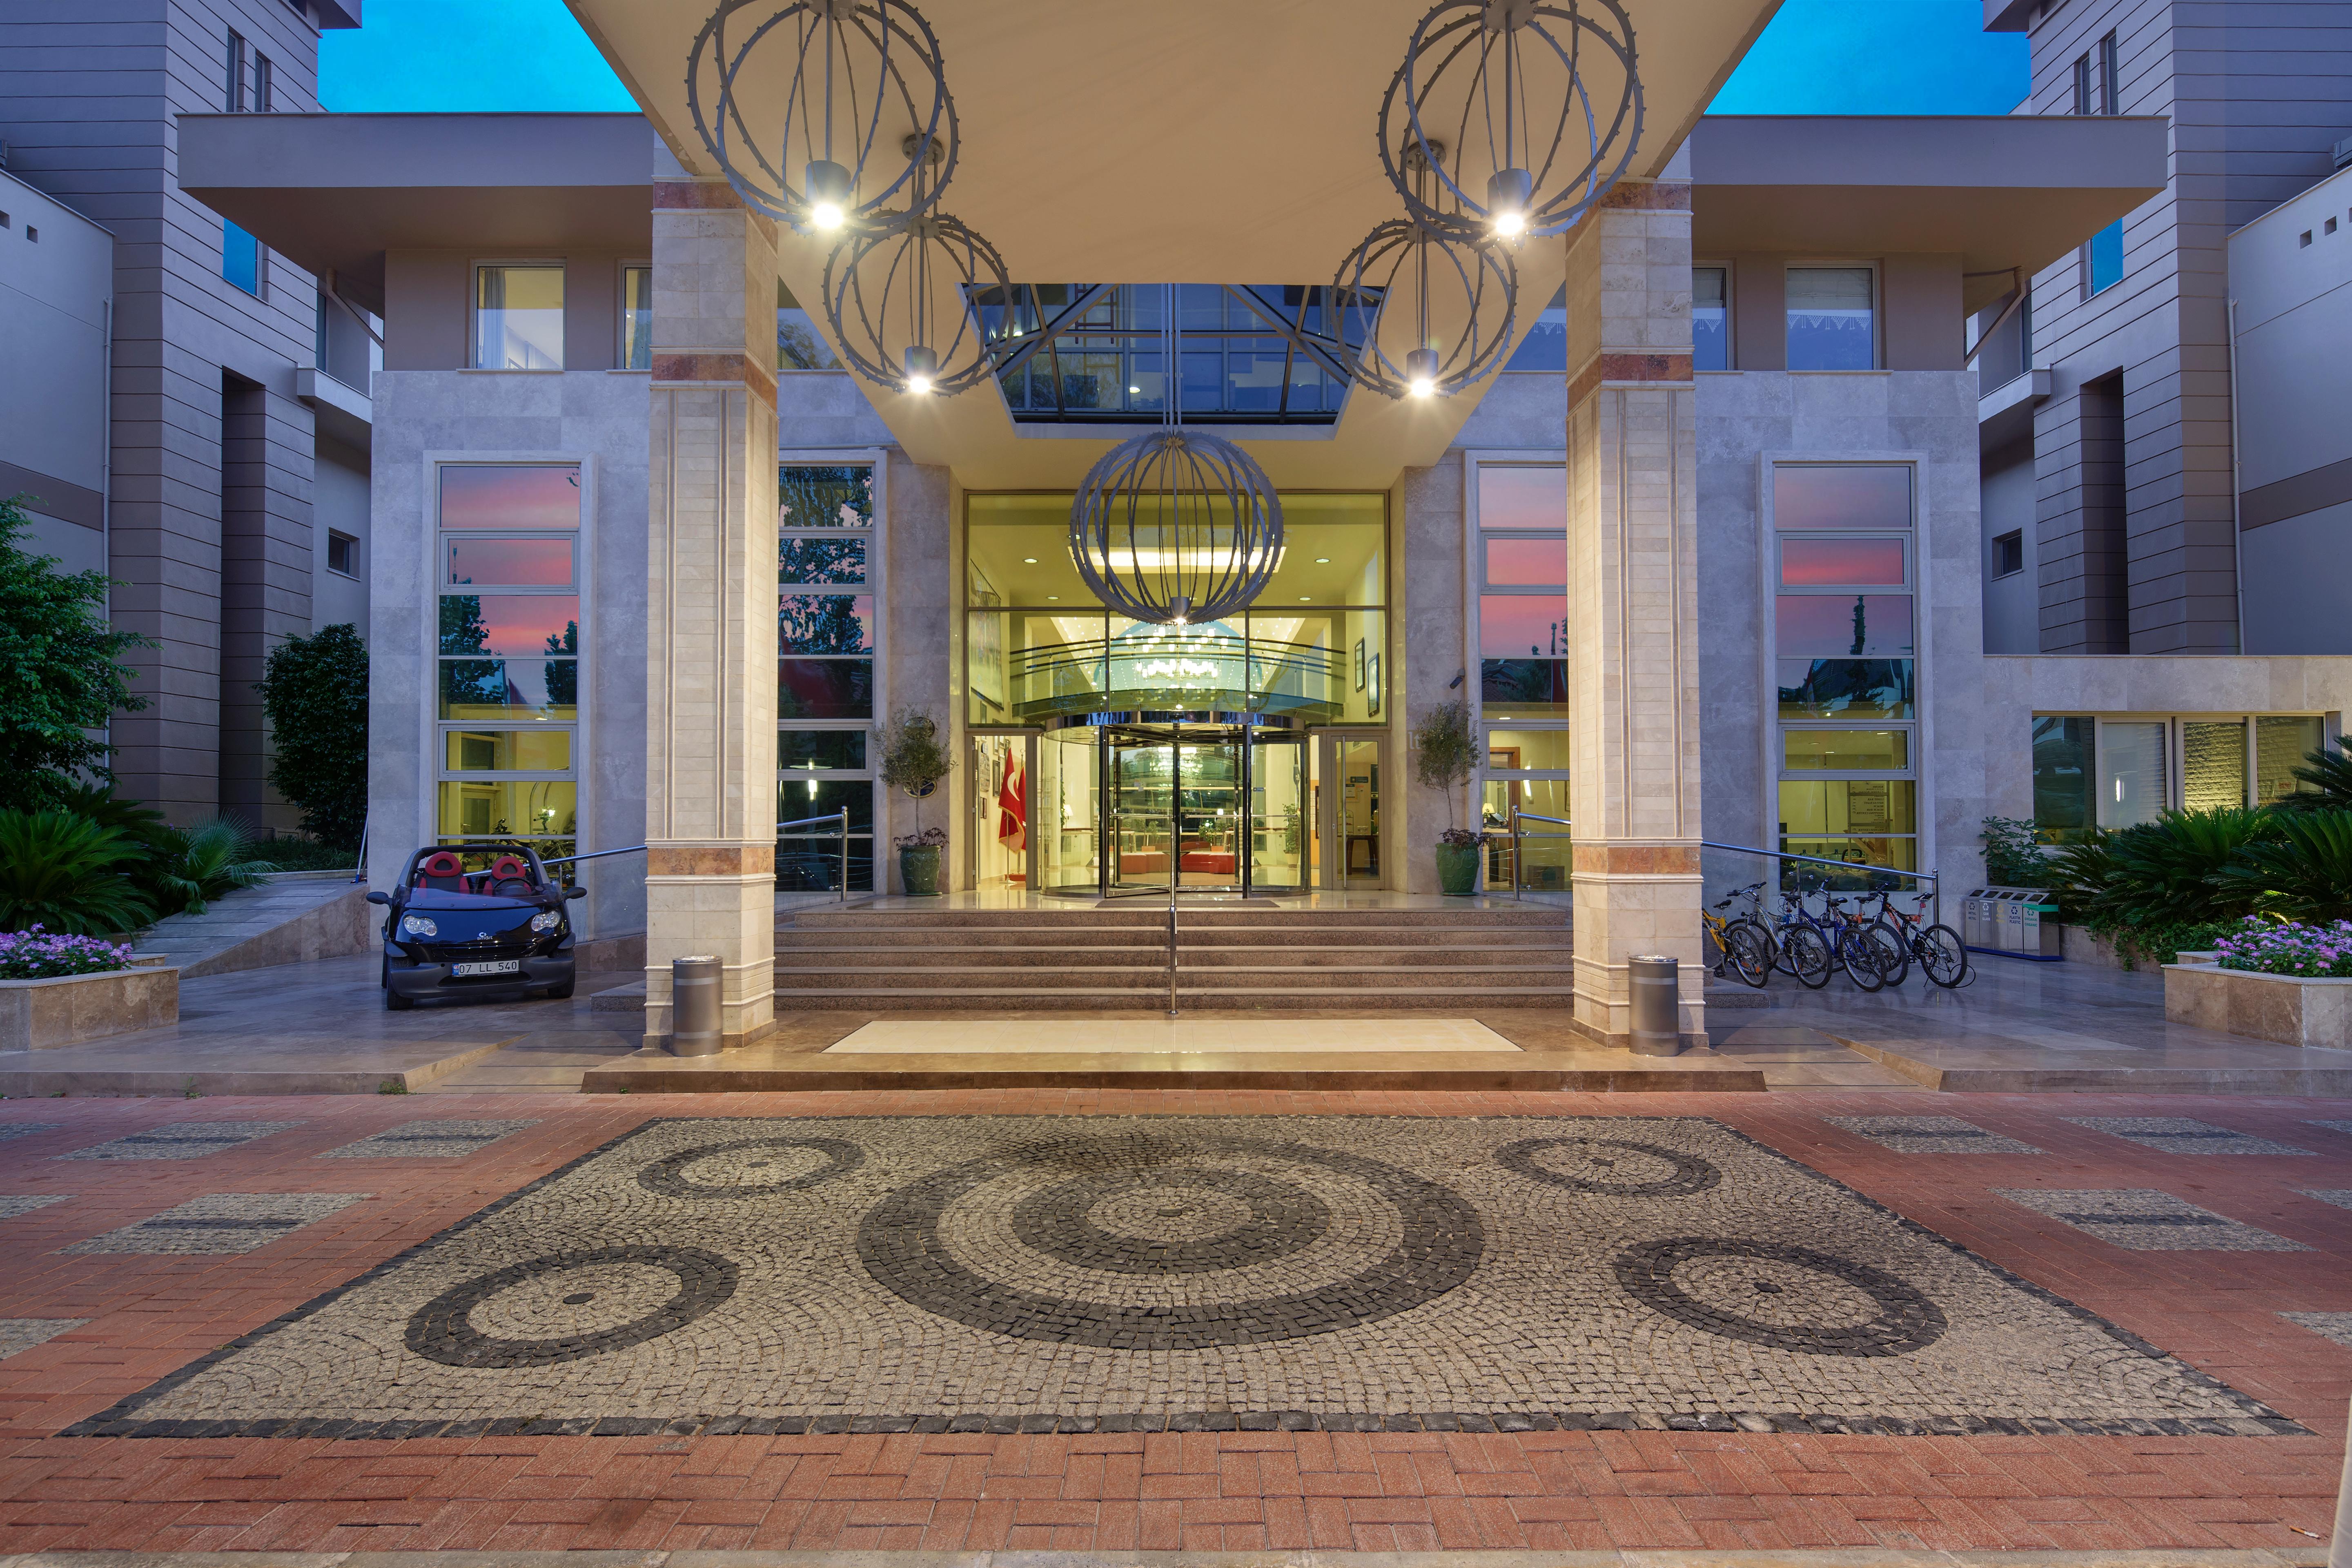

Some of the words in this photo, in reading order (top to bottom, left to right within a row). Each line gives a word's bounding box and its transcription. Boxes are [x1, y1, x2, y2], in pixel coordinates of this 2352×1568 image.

[459, 965, 472, 973] 07
[479, 964, 492, 972] LL
[498, 961, 517, 971] 540
